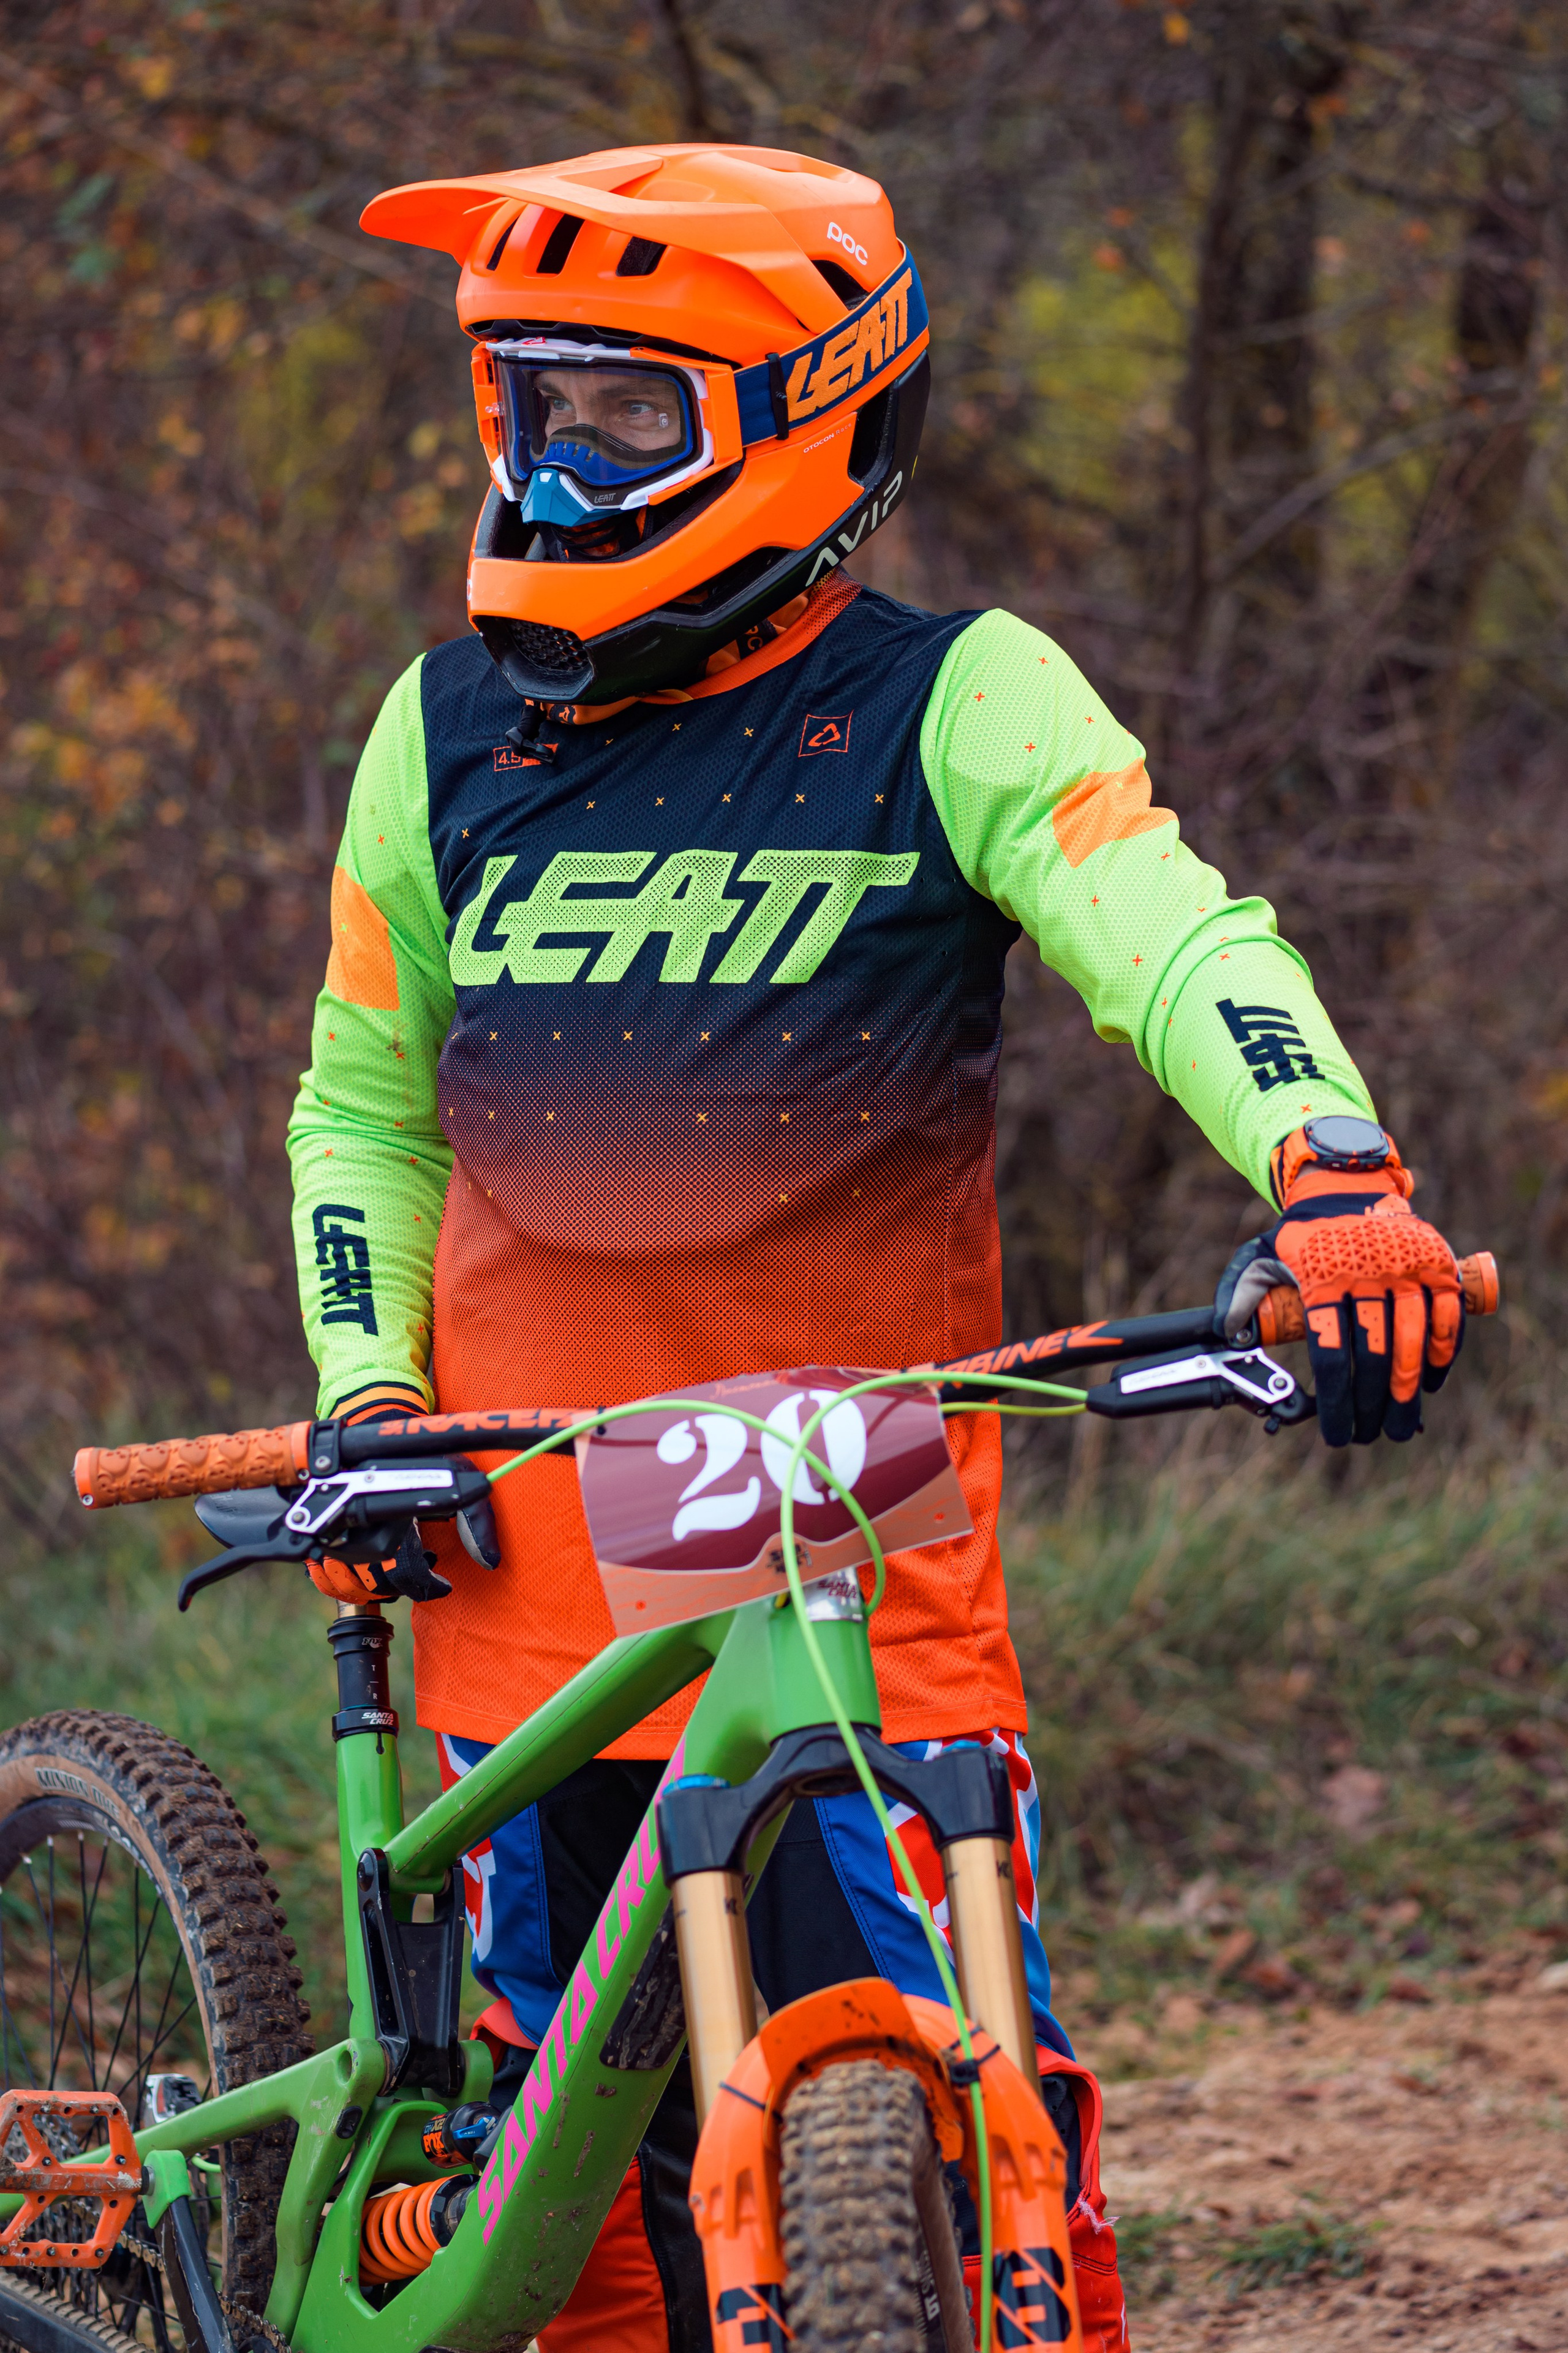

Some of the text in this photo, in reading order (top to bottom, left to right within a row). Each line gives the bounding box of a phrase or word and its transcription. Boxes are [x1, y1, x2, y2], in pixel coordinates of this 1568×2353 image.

[827, 222, 869, 266] POC
[786, 267, 912, 422] LEATT
[594, 493, 616, 504] LEATT
[803, 432, 834, 453] OTOCON
[448, 849, 921, 986] LEATT
[1215, 998, 1325, 1092] EATT
[312, 1204, 379, 1337] LEATT
[656, 1389, 867, 1541] 20
[361, 1637, 383, 1648] FOX
[478, 1960, 598, 2246] SANTA
